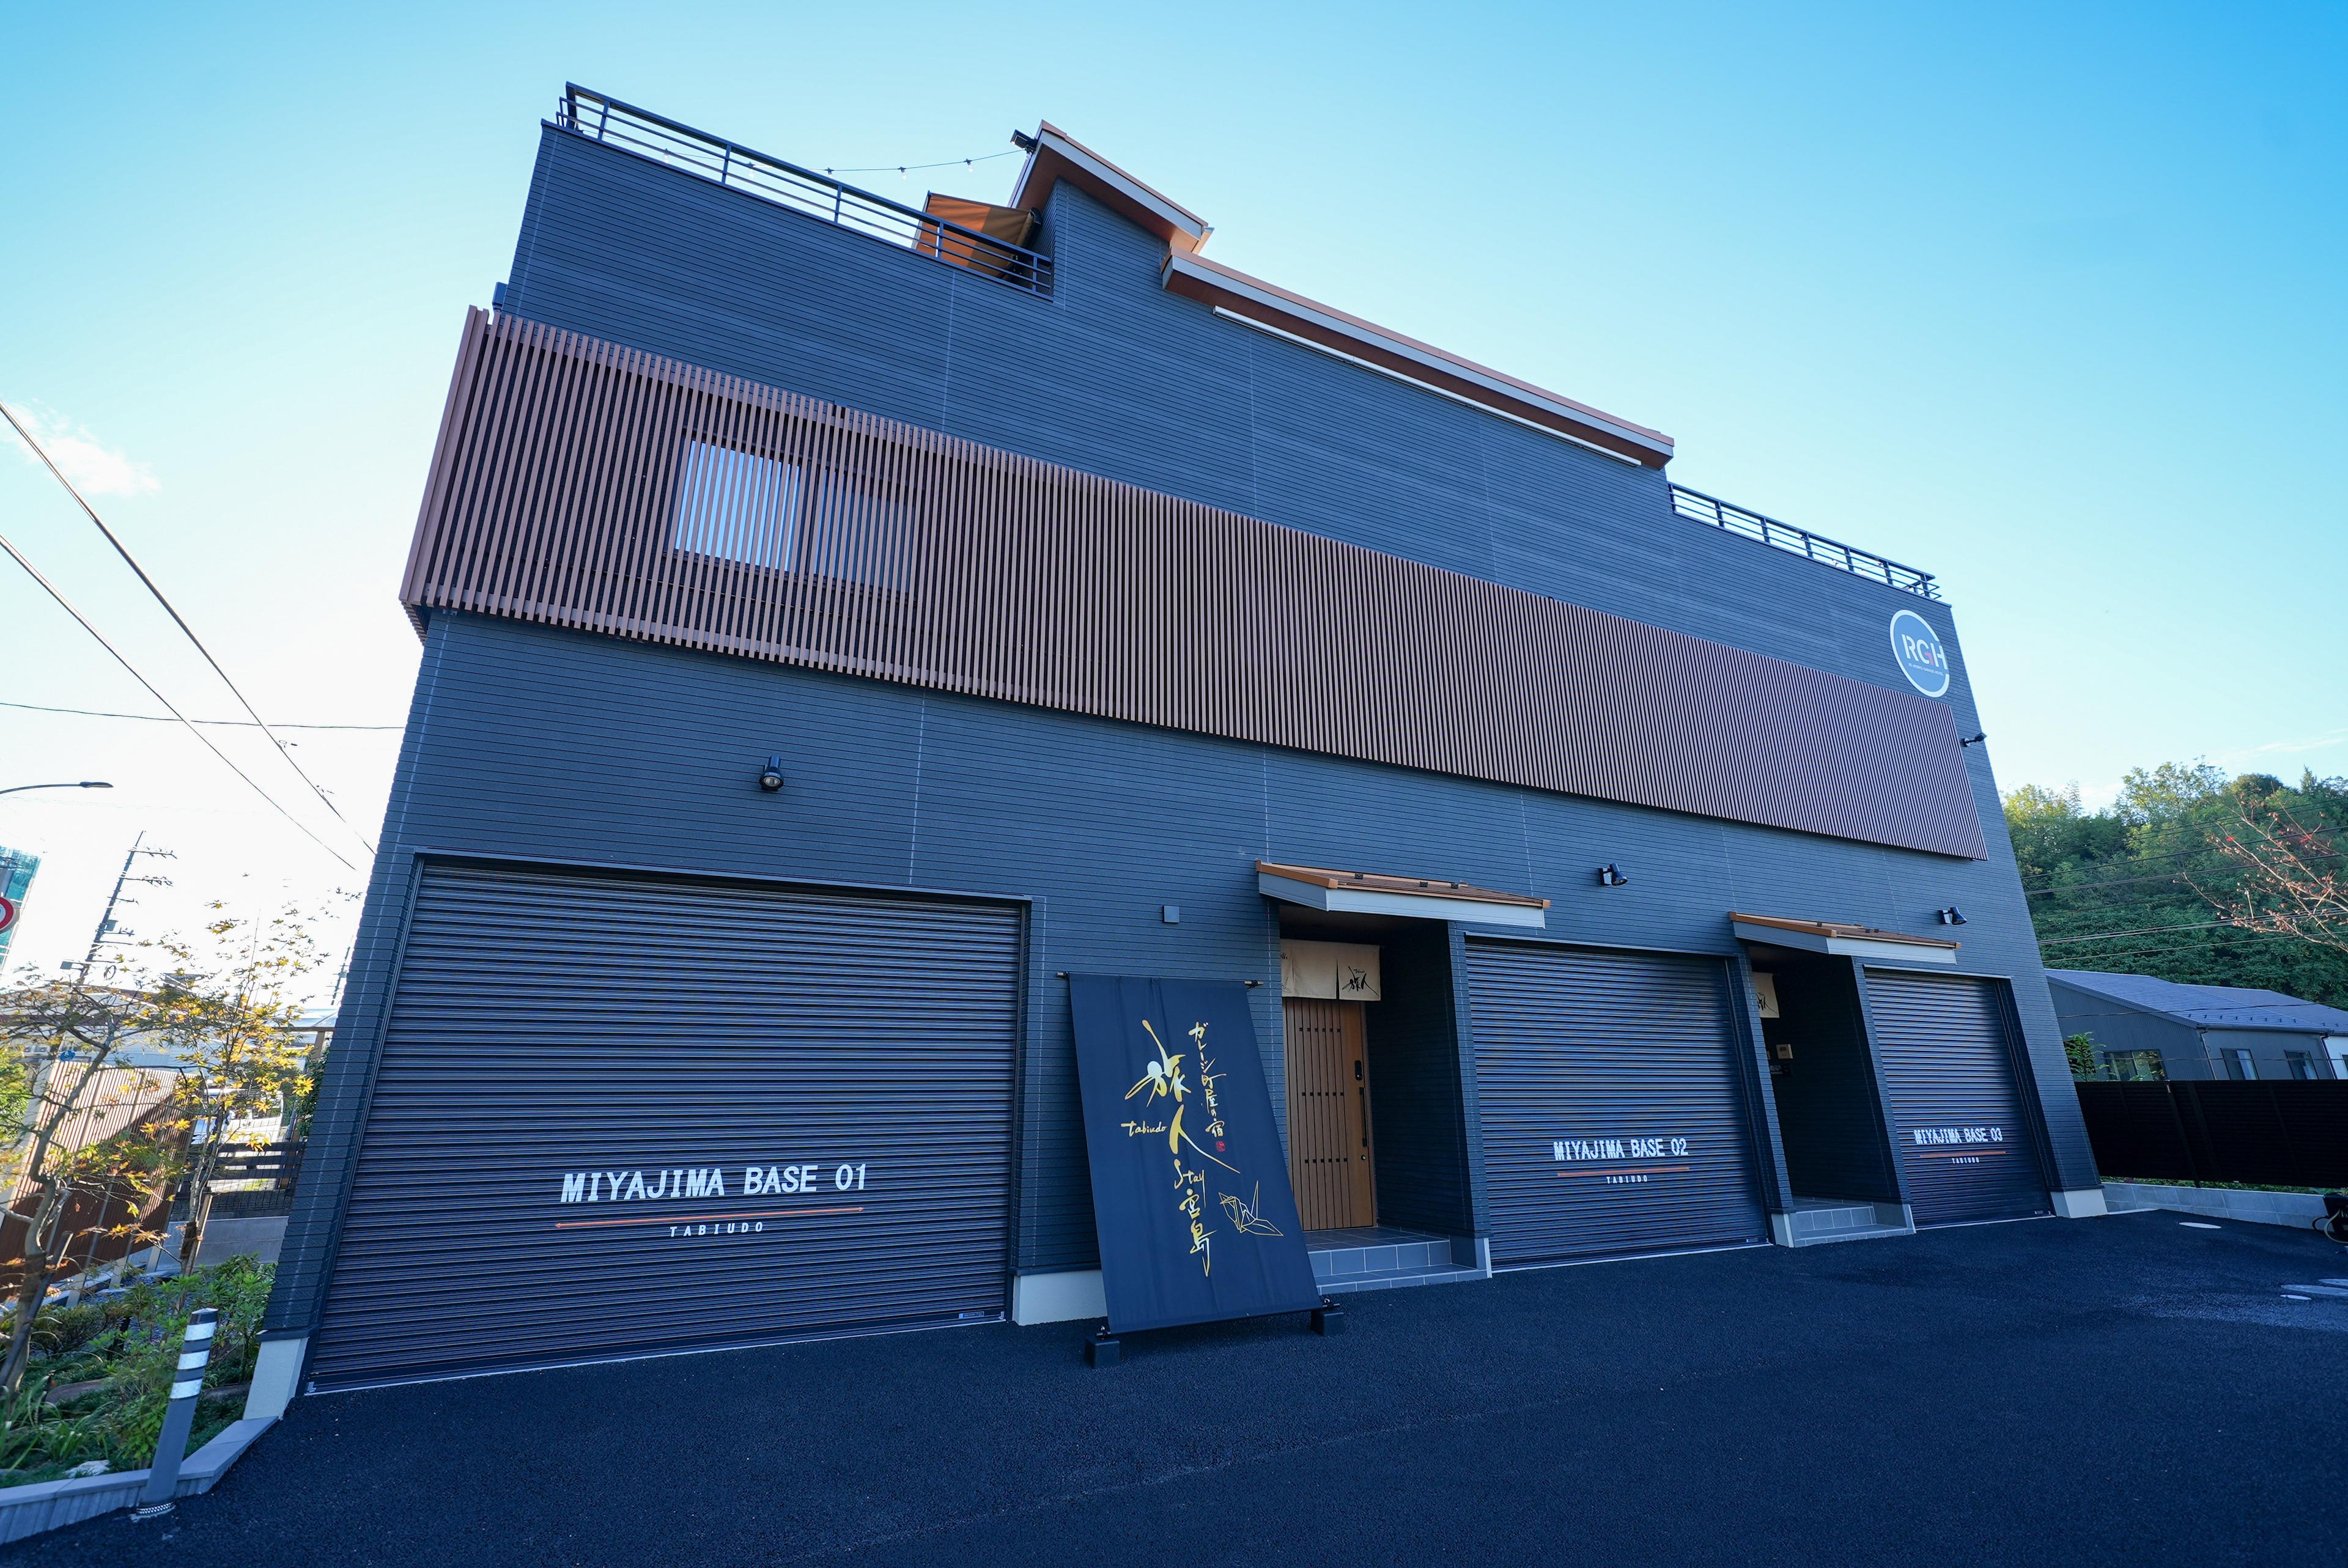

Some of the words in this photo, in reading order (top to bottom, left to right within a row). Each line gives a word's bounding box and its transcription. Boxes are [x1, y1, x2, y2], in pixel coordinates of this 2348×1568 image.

[1188, 1021, 1227, 1138] ガレージ町屋の宿
[1914, 1128, 1962, 1145] MIYAJIMA
[1964, 1127, 1988, 1143] BASE
[1990, 1127, 2003, 1141] 03
[1553, 1139, 1625, 1161] MIYAJIMA
[1631, 1138, 1665, 1157] BASE
[1671, 1138, 1689, 1156] 02
[561, 1168, 725, 1202] MIYAJIMA
[744, 1165, 818, 1194] BASE
[835, 1164, 866, 1190] 01
[1606, 1175, 1648, 1184] TABIUDO
[670, 1221, 764, 1237] TABIUDO
[1179, 1188, 1217, 1276] 宮島
